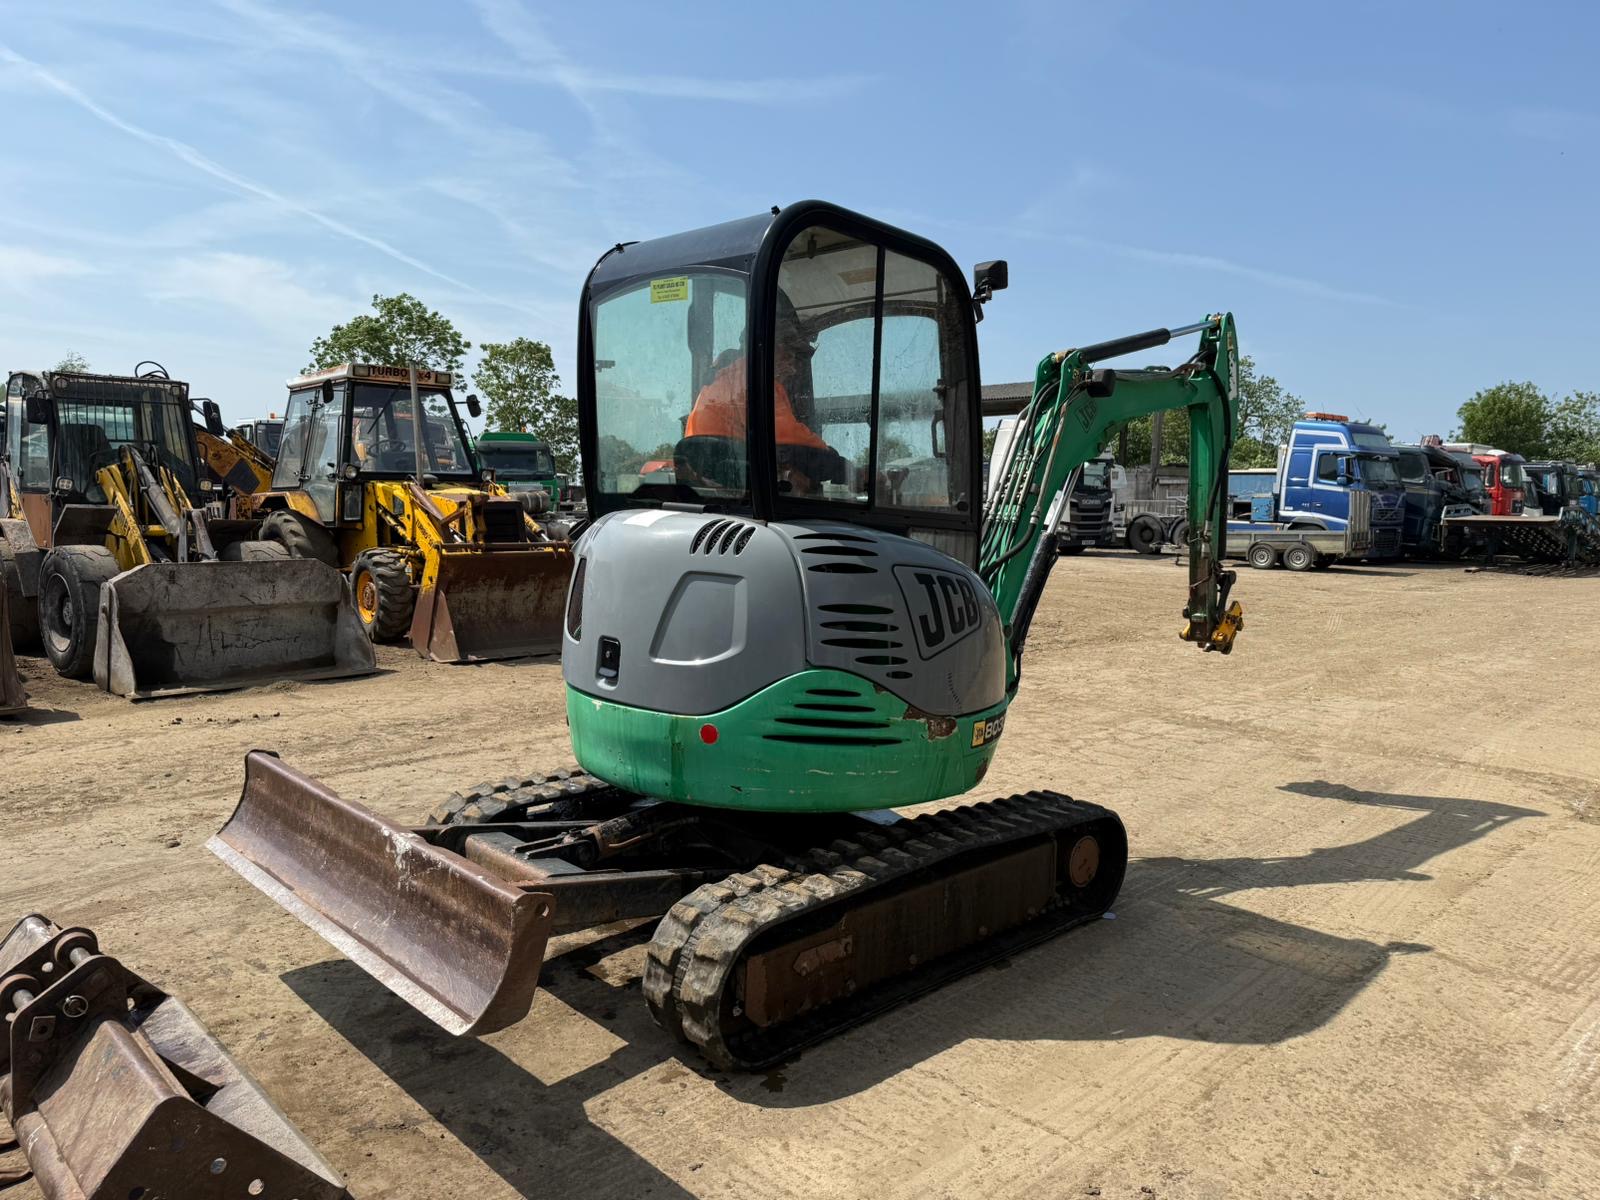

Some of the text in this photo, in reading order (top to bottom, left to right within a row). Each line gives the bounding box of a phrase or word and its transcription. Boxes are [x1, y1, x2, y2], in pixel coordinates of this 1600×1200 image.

[370, 366, 408, 378] TURBO
[1078, 401, 1098, 430] JCB
[914, 573, 980, 648] JCB
